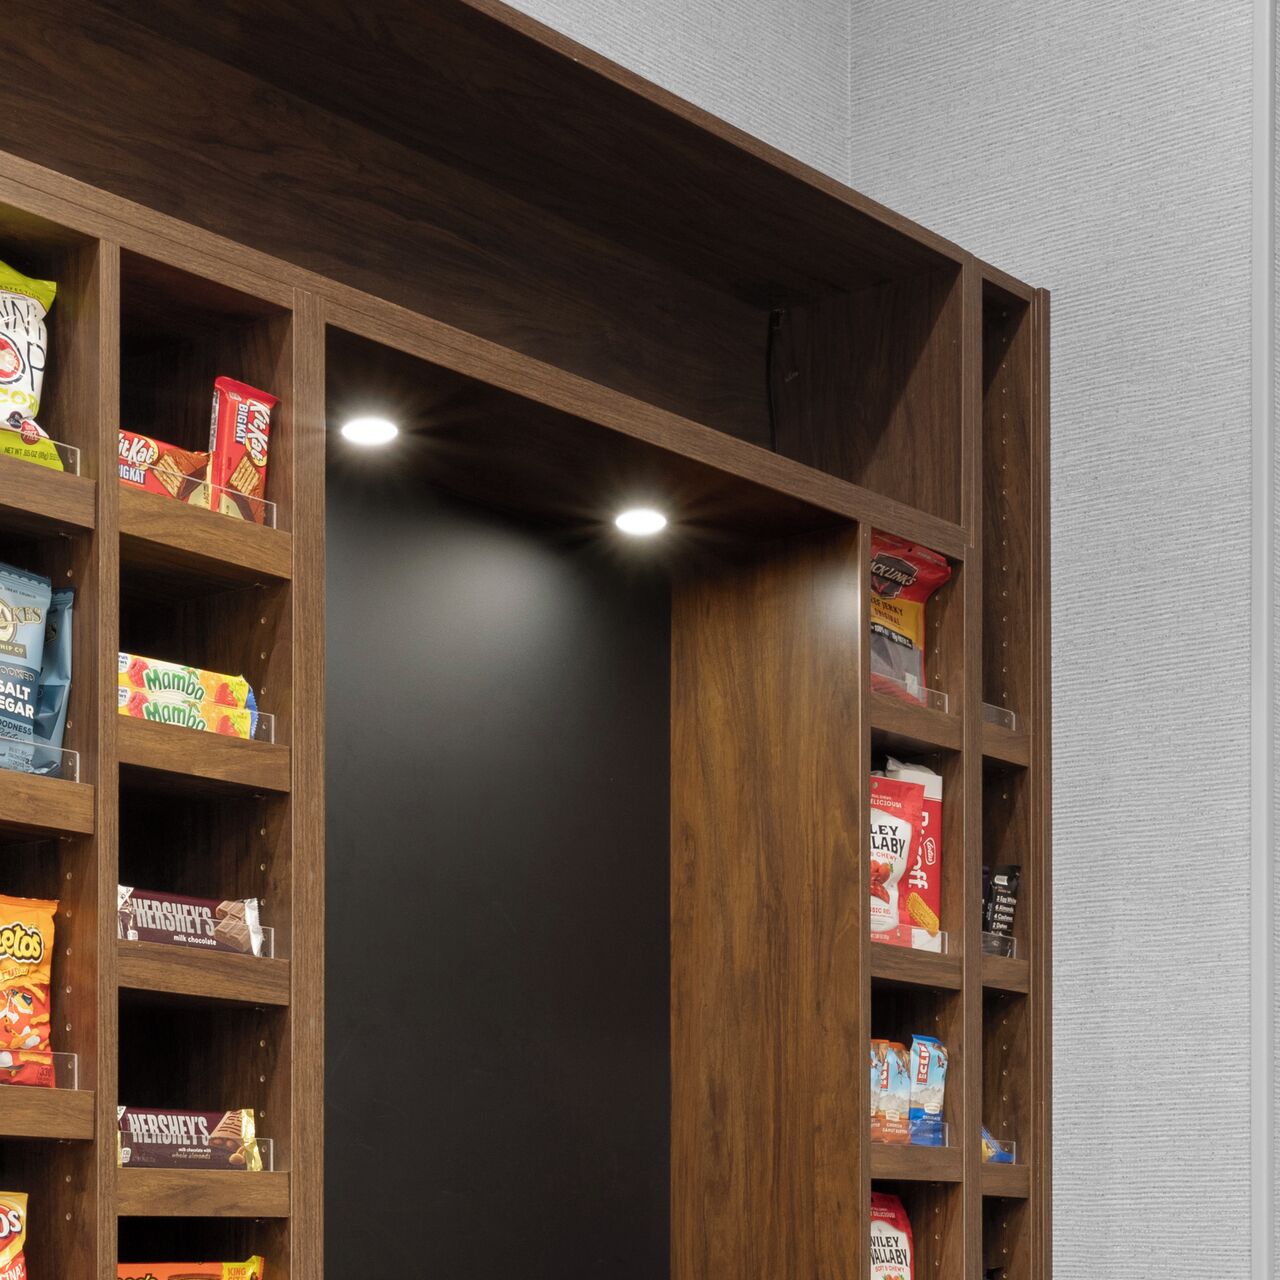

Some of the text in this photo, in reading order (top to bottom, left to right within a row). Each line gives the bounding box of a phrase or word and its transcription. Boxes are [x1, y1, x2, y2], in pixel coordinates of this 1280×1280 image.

[143, 667, 206, 702] Mamba
[876, 852, 898, 861] CHEWY
[131, 896, 216, 938] HERSHEY'S
[173, 934, 218, 947] milk chocolate
[127, 1112, 211, 1147] HERSHEY'S
[171, 1152, 212, 1161] whole almonds
[227, 1267, 247, 1276] KING
